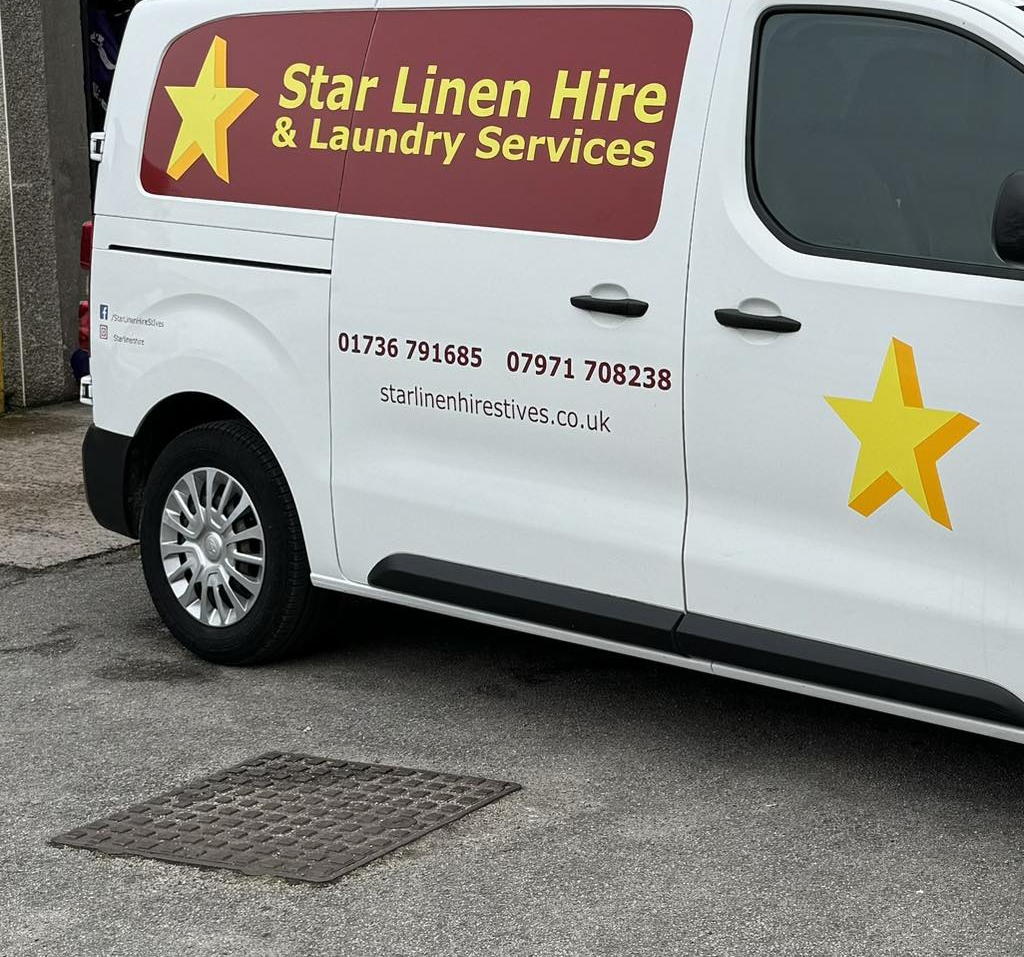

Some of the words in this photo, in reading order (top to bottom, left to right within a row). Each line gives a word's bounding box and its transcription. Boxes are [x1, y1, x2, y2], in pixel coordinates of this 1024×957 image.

[280, 63, 380, 112] Star
[391, 66, 531, 118] Linen
[550, 68, 668, 124] Hire
[271, 117, 297, 148] &
[310, 118, 465, 165] Laundry
[475, 126, 656, 168] Services
[338, 332, 399, 358] 01736
[406, 339, 483, 368] 791685
[507, 351, 575, 380] 07971
[584, 359, 672, 391] 708238
[380, 384, 612, 433] starlinenhirestives.co.uk
